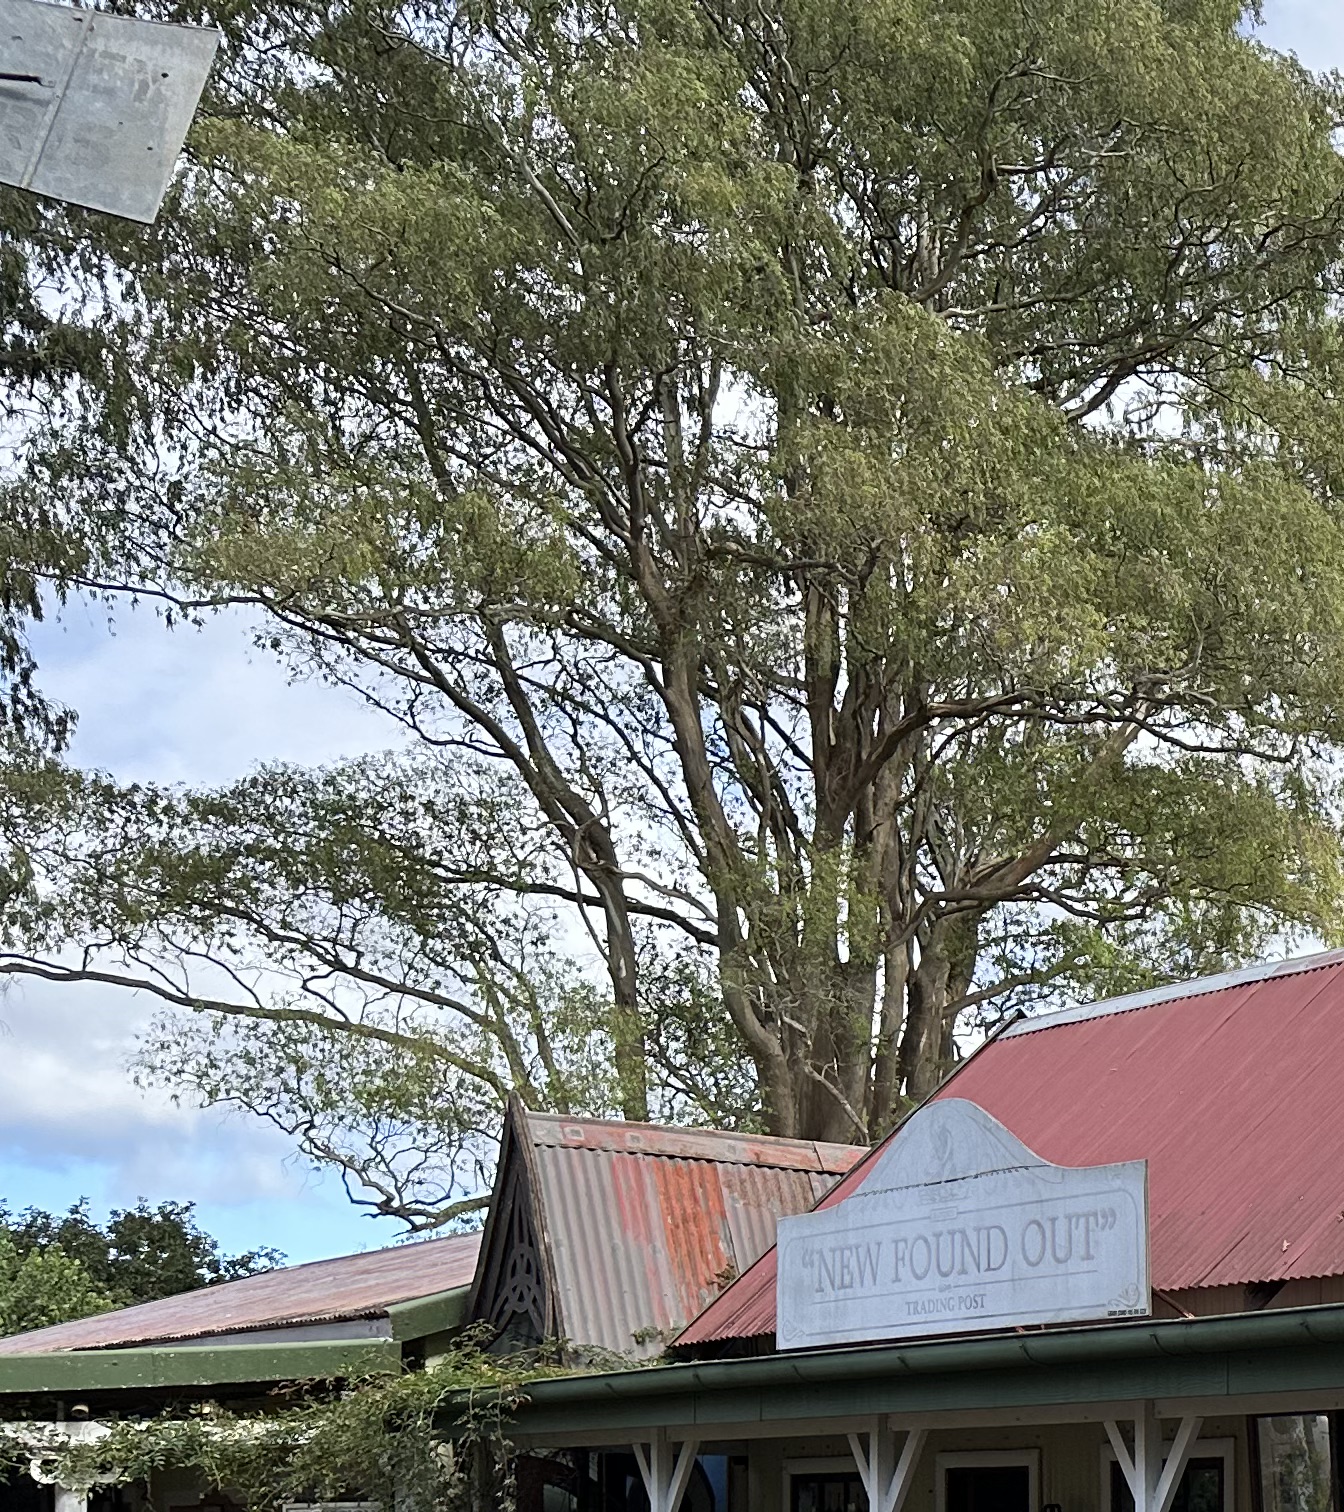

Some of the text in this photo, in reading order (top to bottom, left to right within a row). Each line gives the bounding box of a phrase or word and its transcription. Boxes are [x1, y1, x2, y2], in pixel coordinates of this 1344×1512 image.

[891, 1225, 1009, 1283] FOUND
[905, 1294, 987, 1316] TRADING POST
